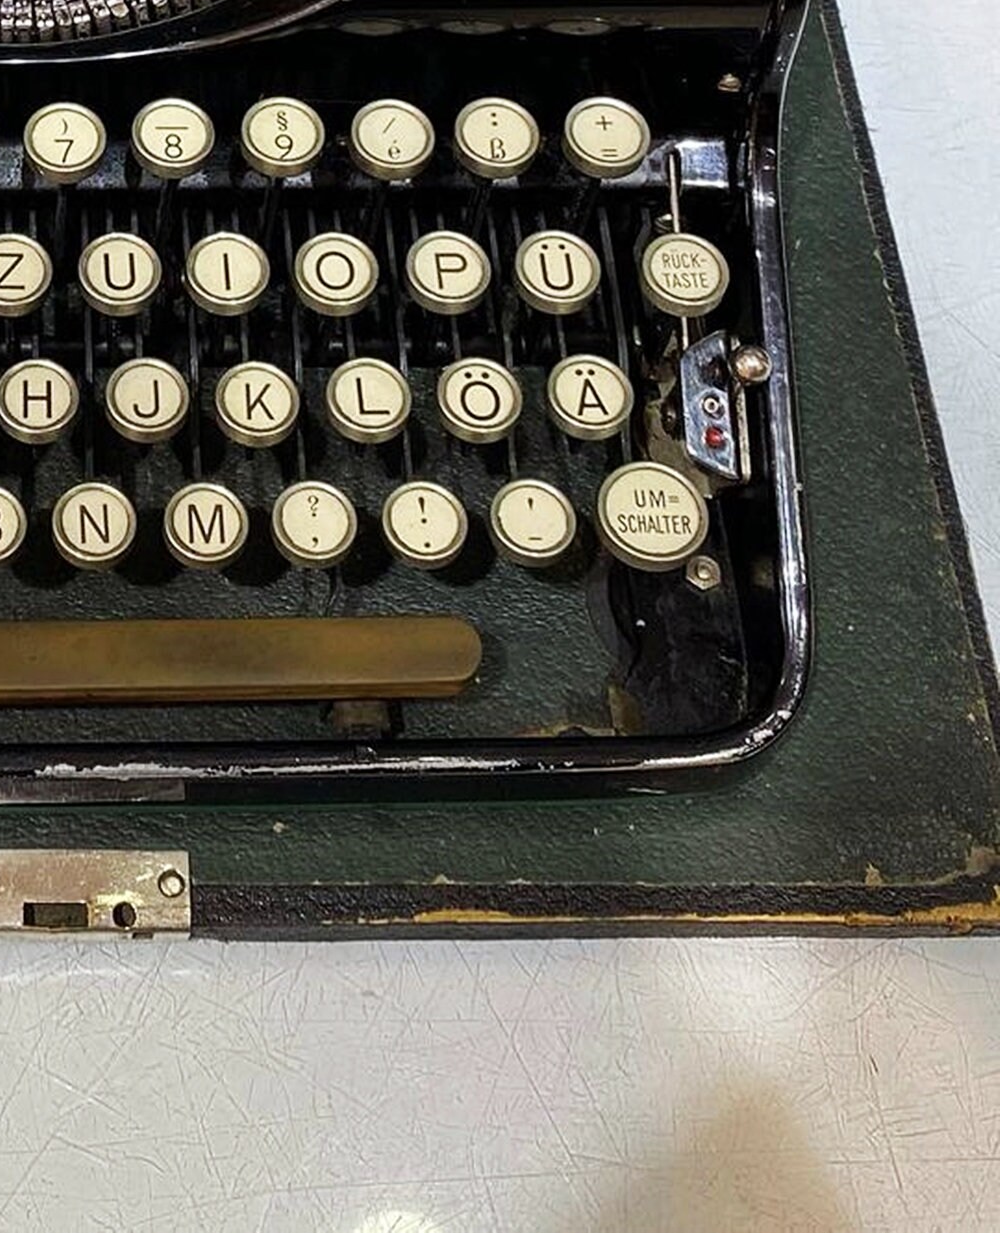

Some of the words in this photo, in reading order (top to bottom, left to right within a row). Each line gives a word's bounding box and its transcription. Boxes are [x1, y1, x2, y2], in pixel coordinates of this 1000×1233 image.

[276, 111, 289, 130] §
[595, 116, 613, 131] +
[54, 139, 74, 163] 7
[164, 134, 182, 158] 8
[274, 134, 293, 159] 9
[103, 252, 135, 290] U
[222, 252, 231, 290] I
[315, 251, 355, 290] O
[434, 253, 468, 289] P
[539, 244, 574, 290] Ü
[661, 248, 706, 269] RÜCK-
[661, 272, 709, 289] TASTE
[22, 379, 52, 419] H
[133, 379, 159, 419] J
[244, 383, 275, 420] K
[356, 377, 391, 415] L
[460, 371, 501, 420] Ö
[574, 368, 609, 416] Ä
[79, 503, 110, 544] N
[187, 503, 226, 545] M
[307, 494, 319, 517] ?
[417, 496, 428, 524] !
[618, 514, 692, 535] SCHALTER
